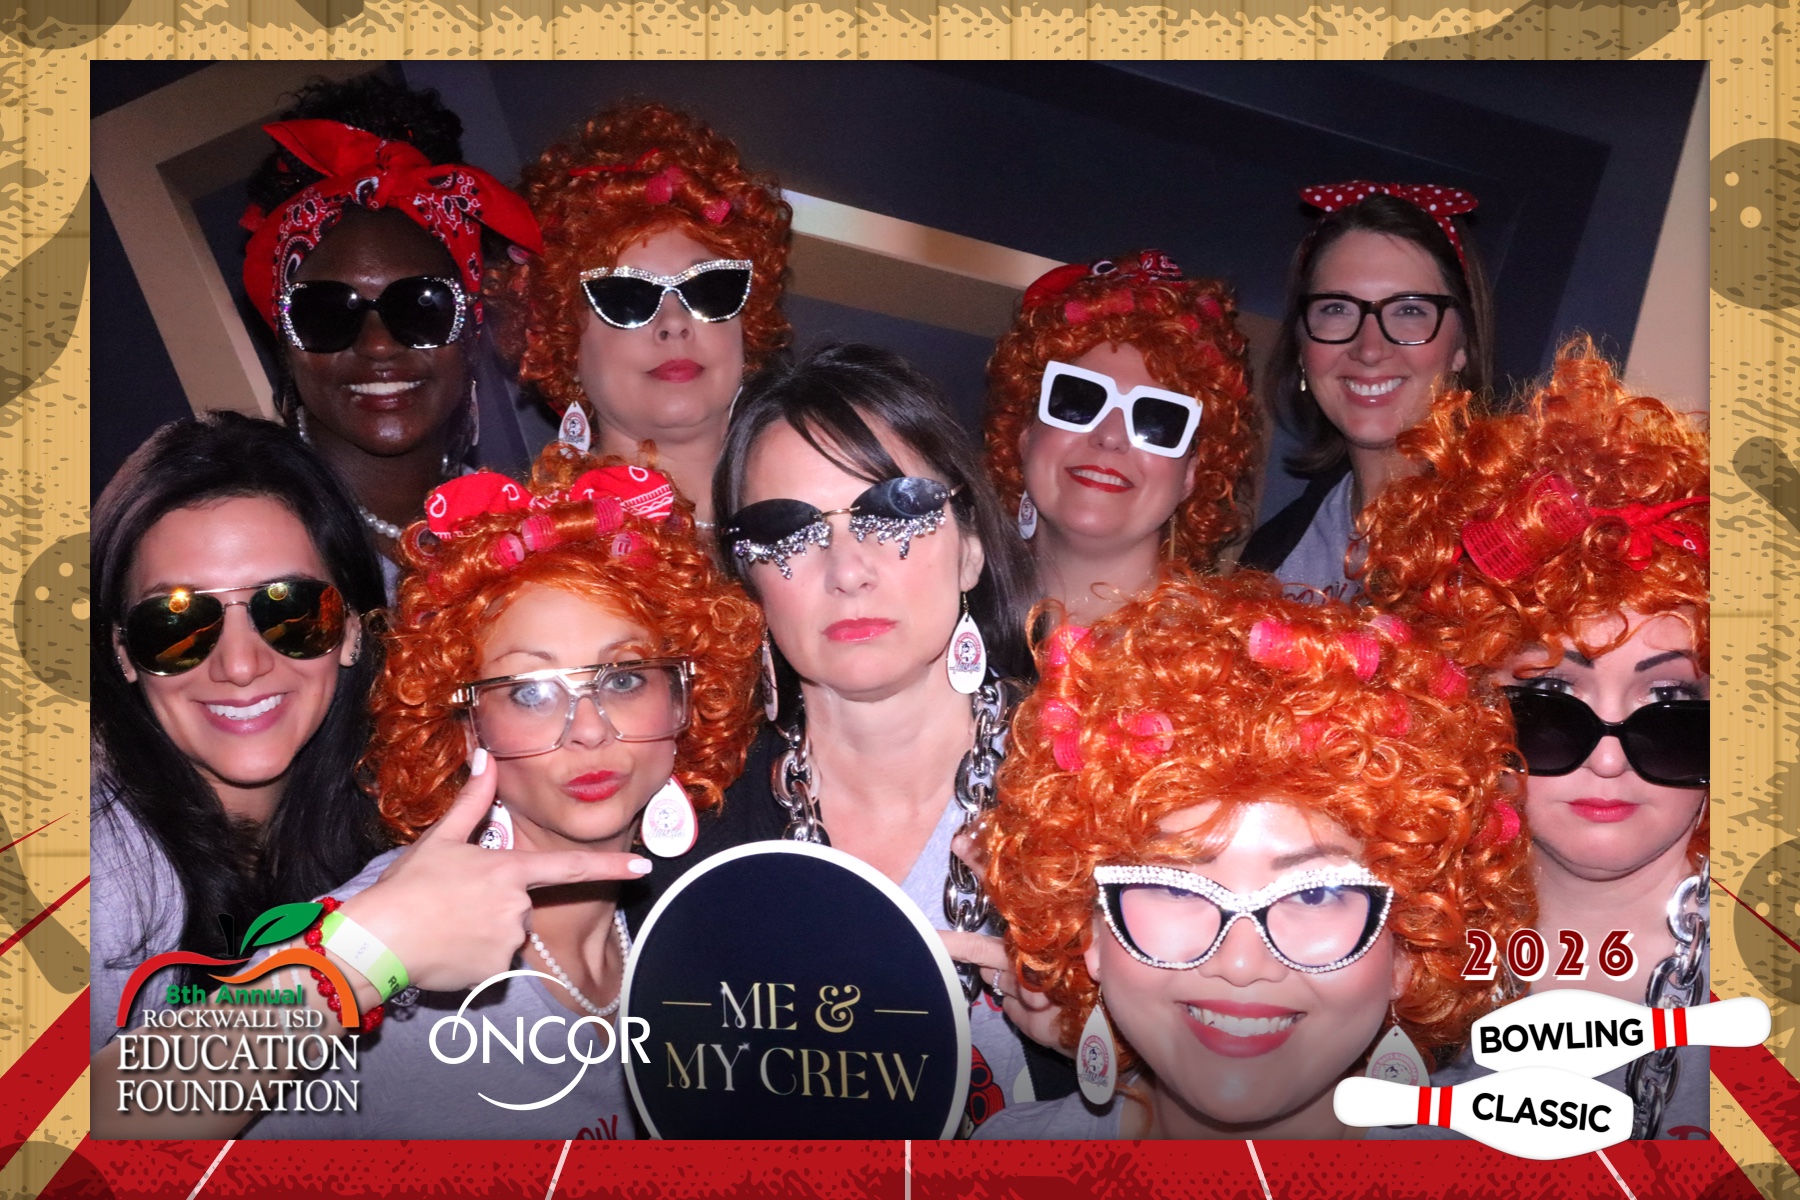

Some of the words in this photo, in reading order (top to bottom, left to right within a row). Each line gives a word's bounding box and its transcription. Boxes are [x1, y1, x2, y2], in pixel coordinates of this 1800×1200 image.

[720, 981, 798, 1031] ME
[815, 984, 861, 1034] &
[665, 1042, 750, 1091] MY
[760, 1047, 929, 1101] CREW
